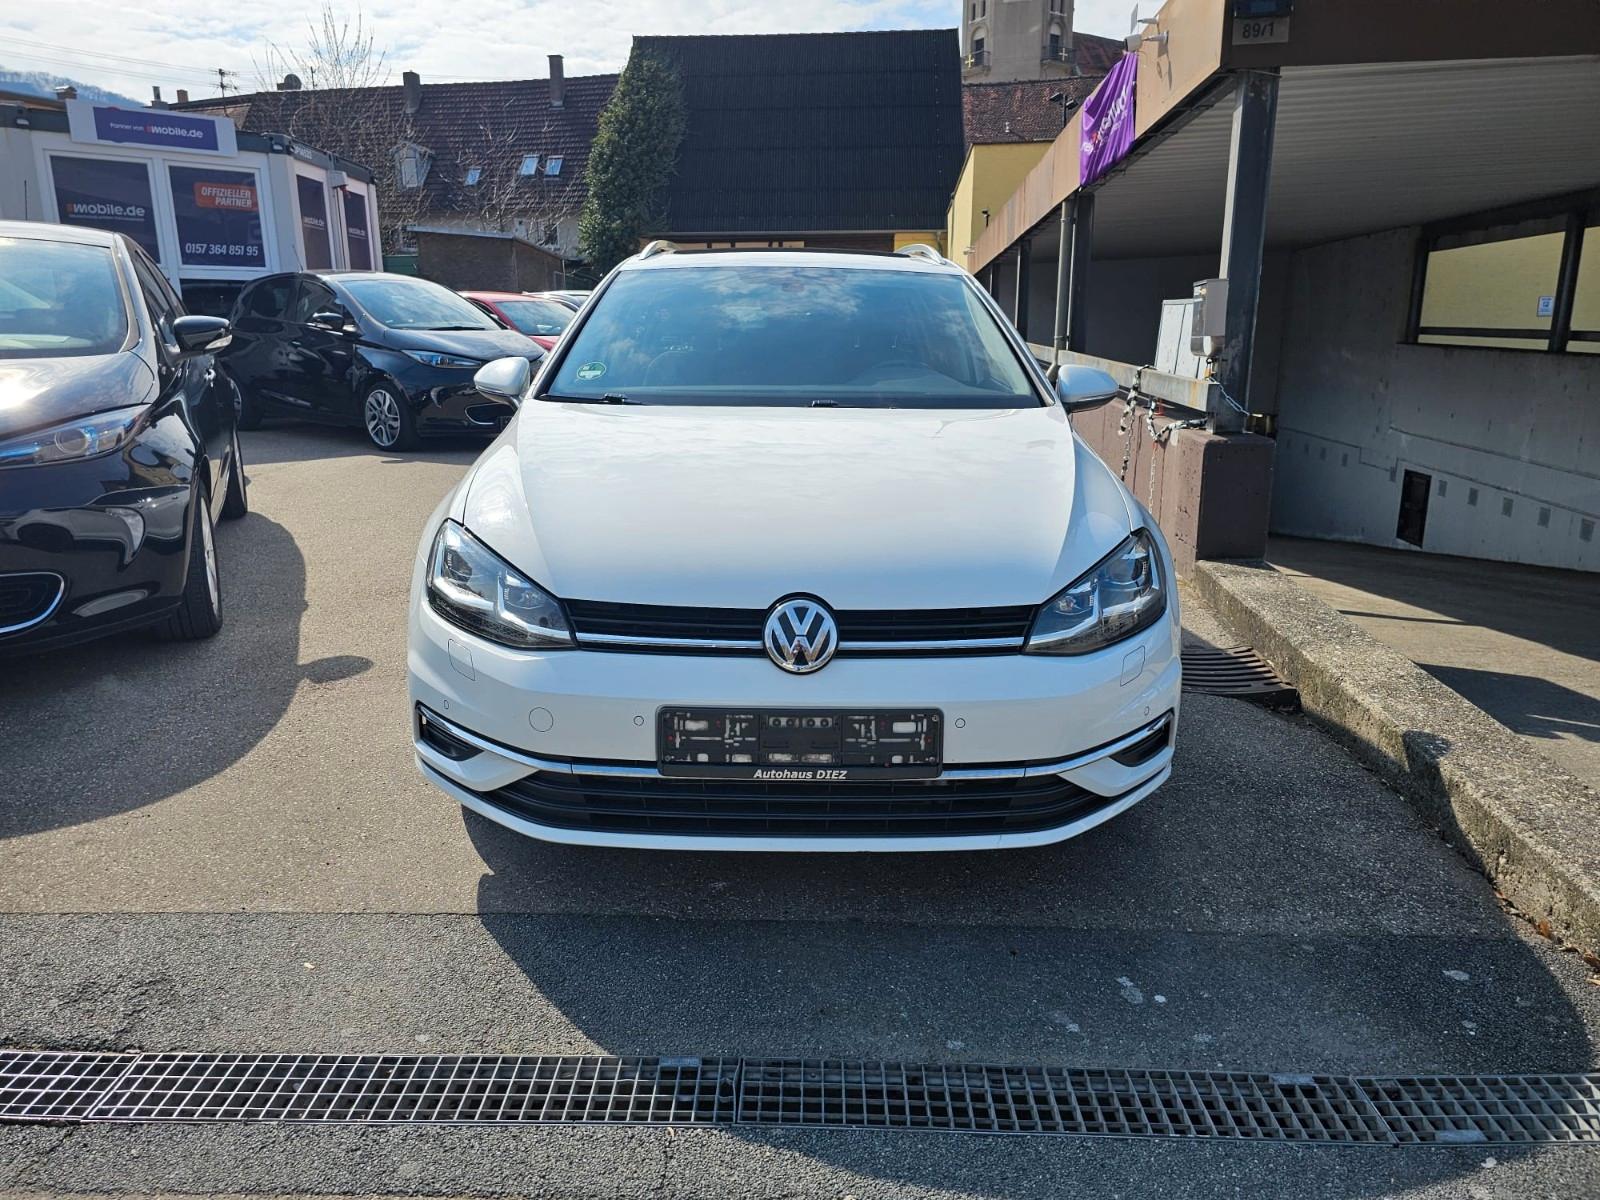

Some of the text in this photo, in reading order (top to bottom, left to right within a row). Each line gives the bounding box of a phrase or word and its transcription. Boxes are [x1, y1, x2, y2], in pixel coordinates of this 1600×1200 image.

[1242, 21, 1275, 39] 89/1
[151, 124, 204, 139] mobile.de
[201, 186, 252, 199] OFFIZIELLER
[73, 202, 146, 217] mobile.de
[215, 196, 253, 209] PARTNER
[185, 242, 259, 257] 0157 364 851 95
[753, 768, 848, 780] Autohaus DIEZ
